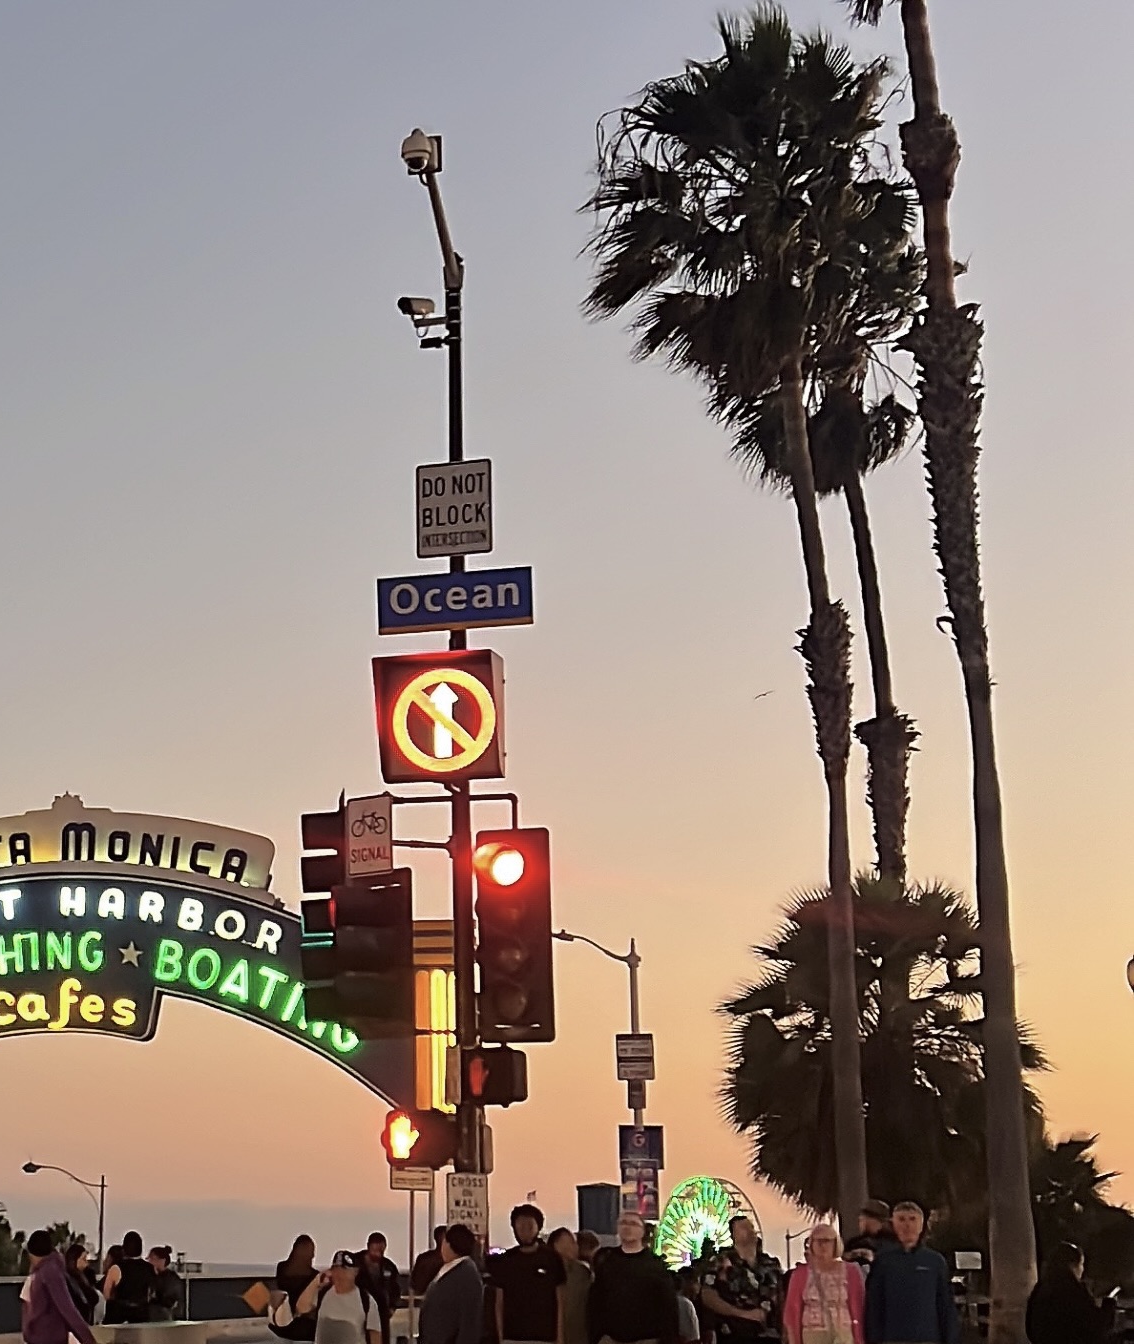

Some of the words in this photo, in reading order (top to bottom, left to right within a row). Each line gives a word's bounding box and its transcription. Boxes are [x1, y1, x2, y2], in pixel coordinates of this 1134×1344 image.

[422, 476, 445, 498] DO
[452, 472, 485, 494] NOT
[422, 502, 486, 527] BLOCK
[389, 582, 519, 614] Ocean
[62, 822, 248, 883] MONICA
[351, 845, 390, 864] SIGNAL
[58, 887, 282, 955] HARBOR
